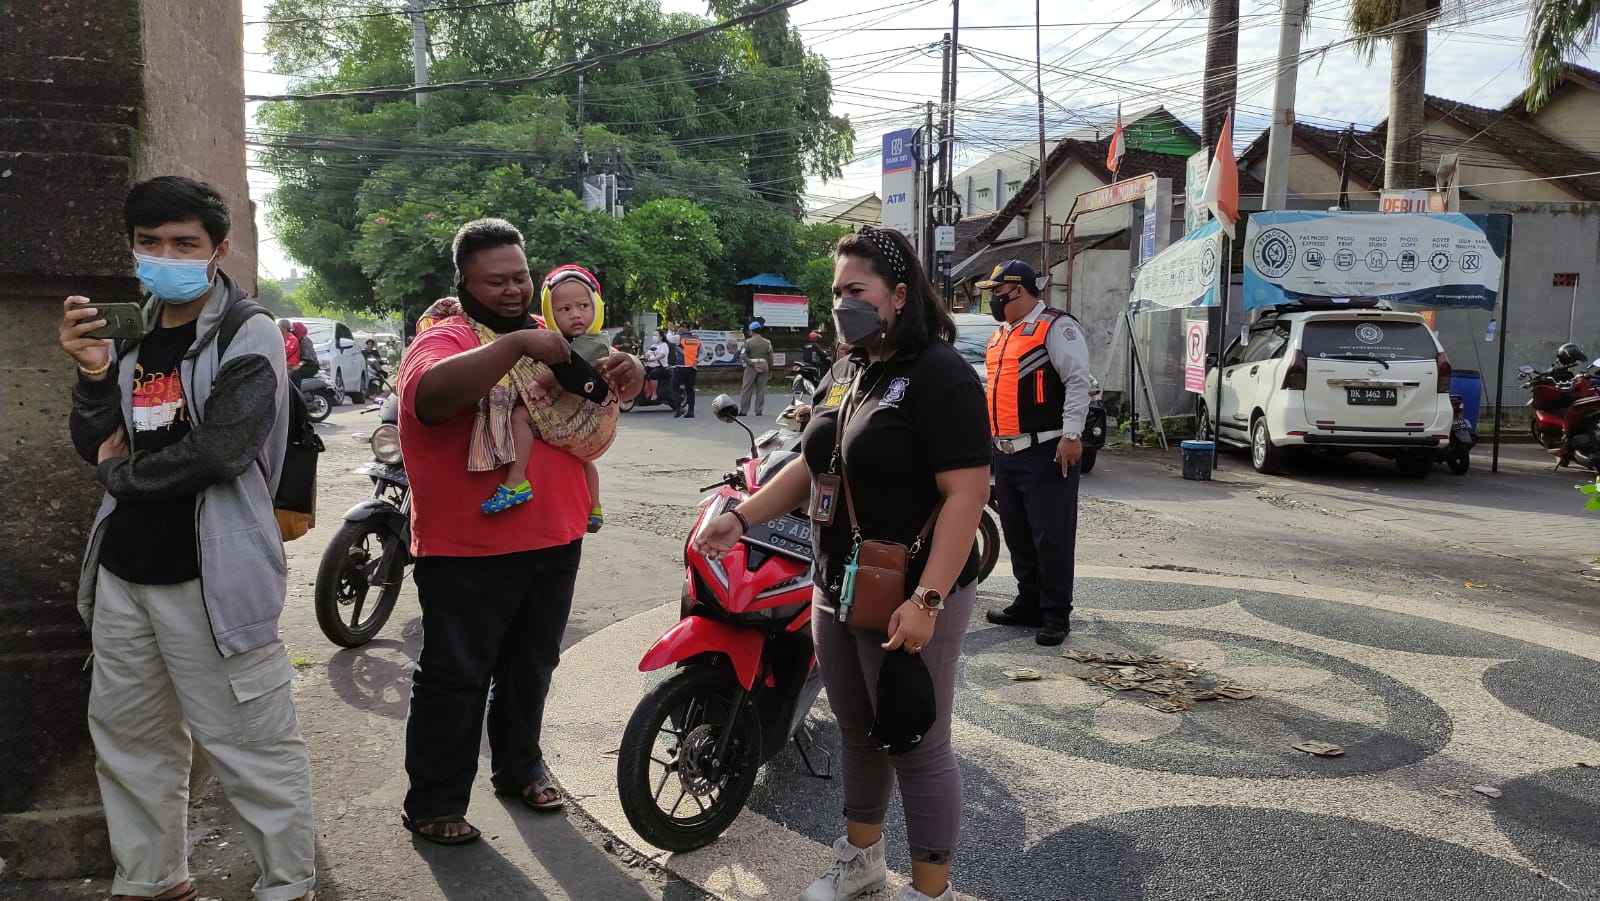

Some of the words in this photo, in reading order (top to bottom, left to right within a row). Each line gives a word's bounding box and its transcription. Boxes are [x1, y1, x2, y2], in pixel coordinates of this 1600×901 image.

[886, 156, 898, 164] BANK
[887, 193, 906, 204] ATM
[1350, 390, 1361, 398] DK
[1365, 390, 1381, 399] 1462
[1386, 390, 1395, 399] FA
